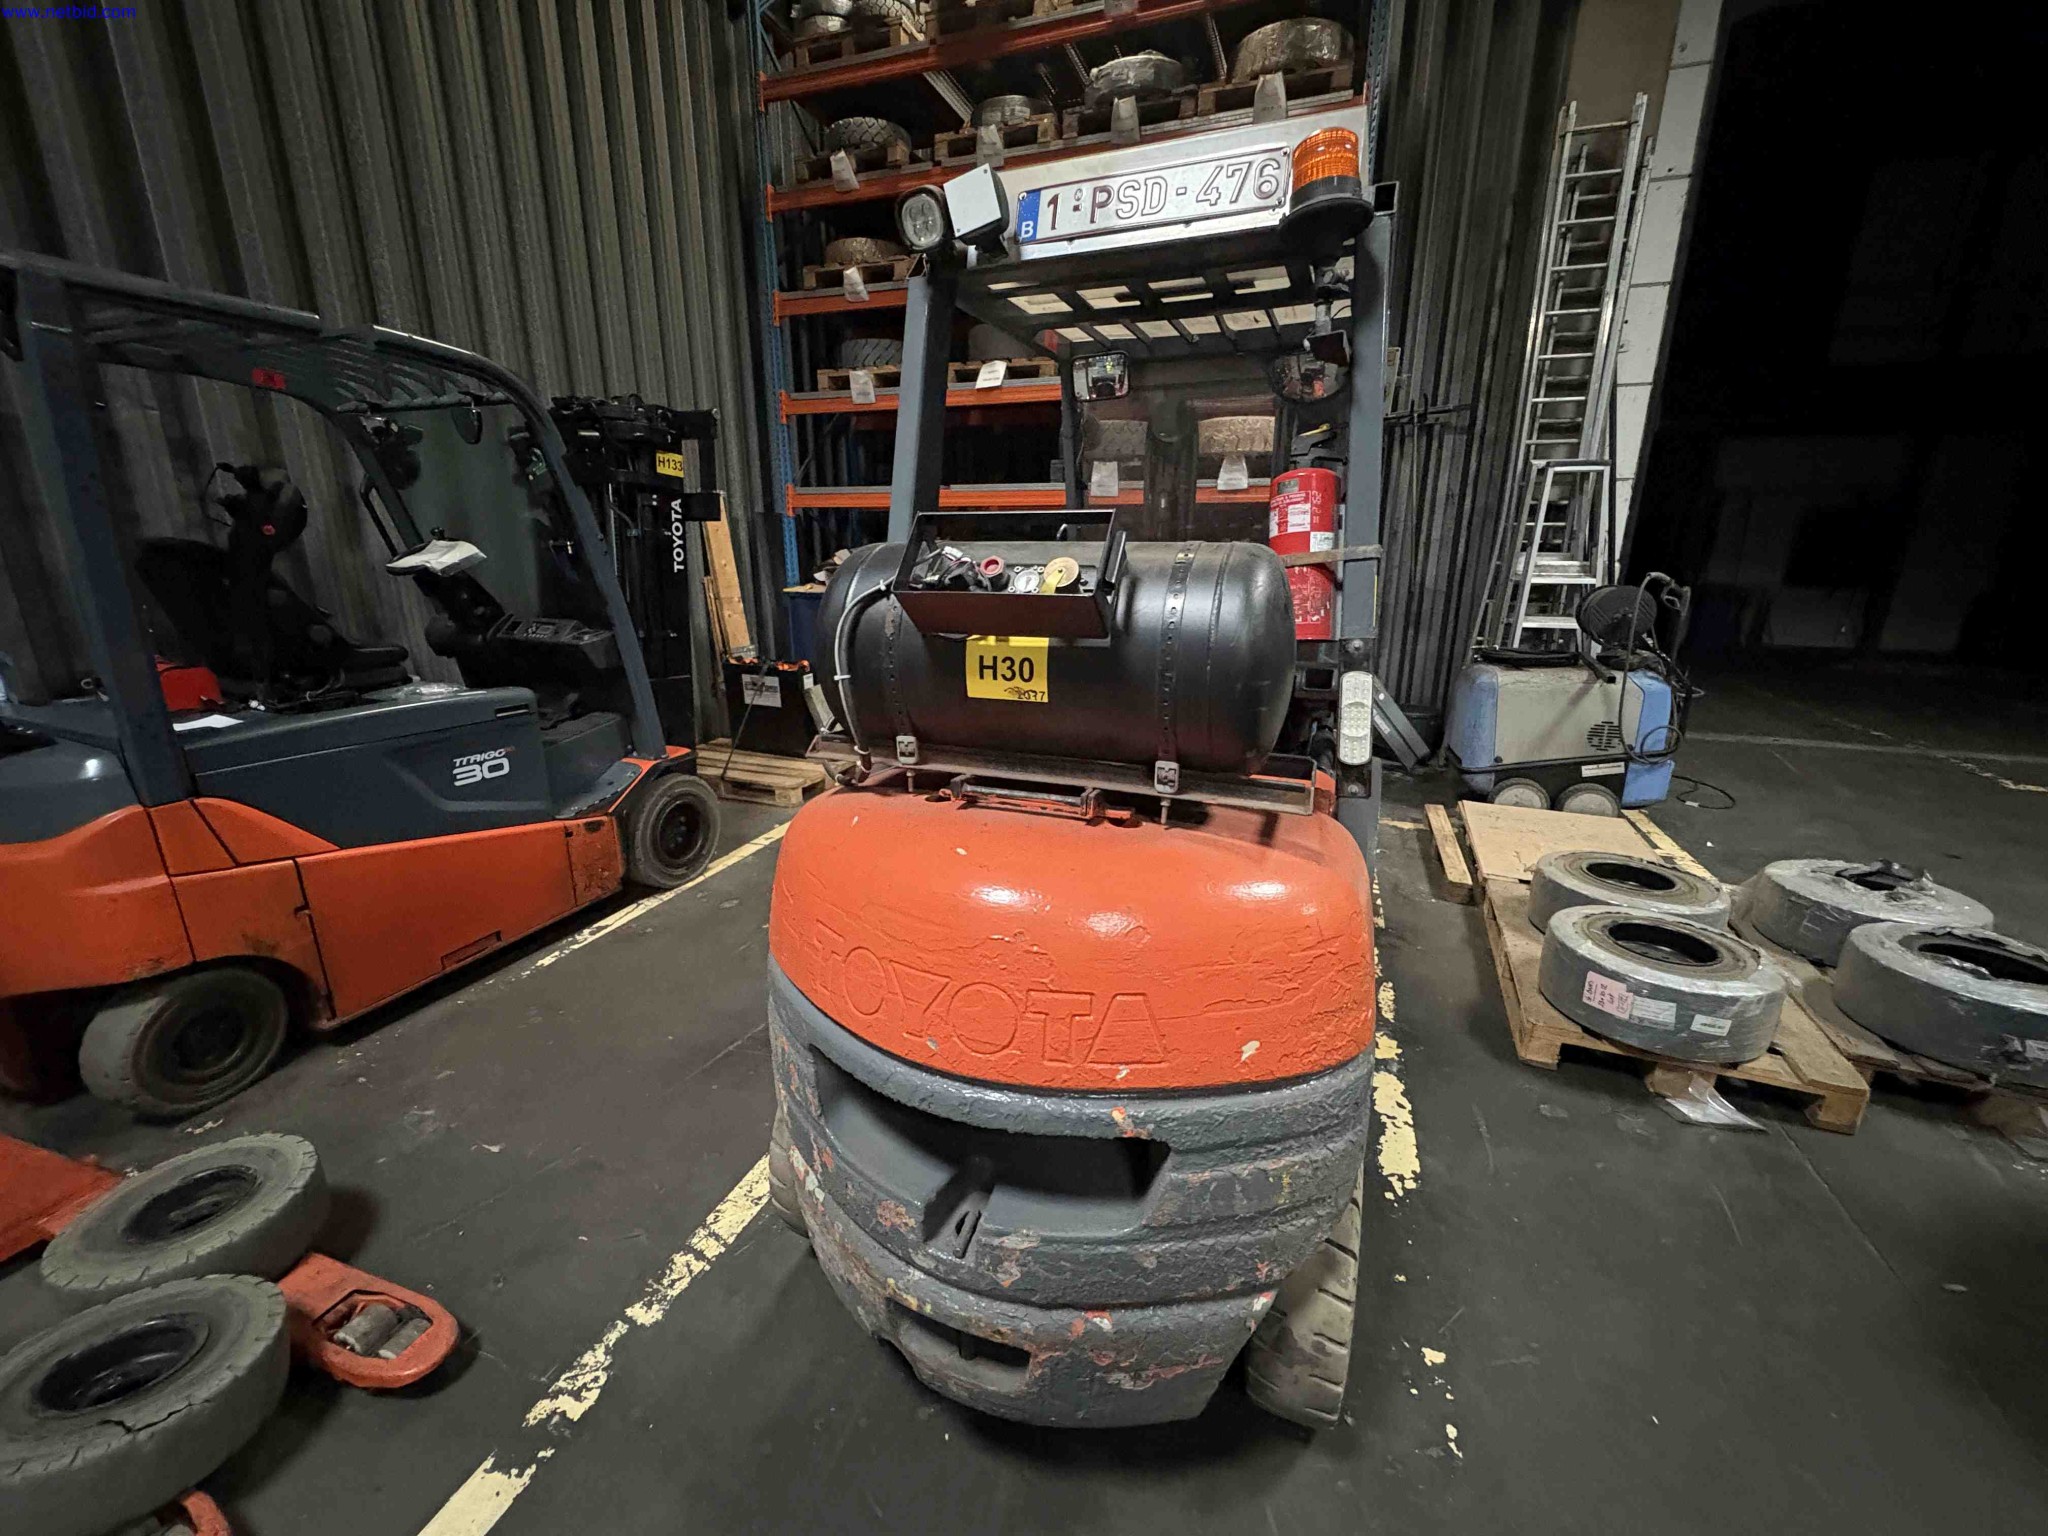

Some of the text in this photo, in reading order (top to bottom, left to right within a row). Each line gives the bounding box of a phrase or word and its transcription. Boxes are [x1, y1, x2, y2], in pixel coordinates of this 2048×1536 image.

[1020, 220, 1034, 239] B
[657, 456, 683, 472] H133
[670, 498, 685, 573] TOYOTA
[978, 655, 1035, 683] H30
[452, 757, 510, 787] 30
[812, 918, 1169, 1068] TOYOTA
